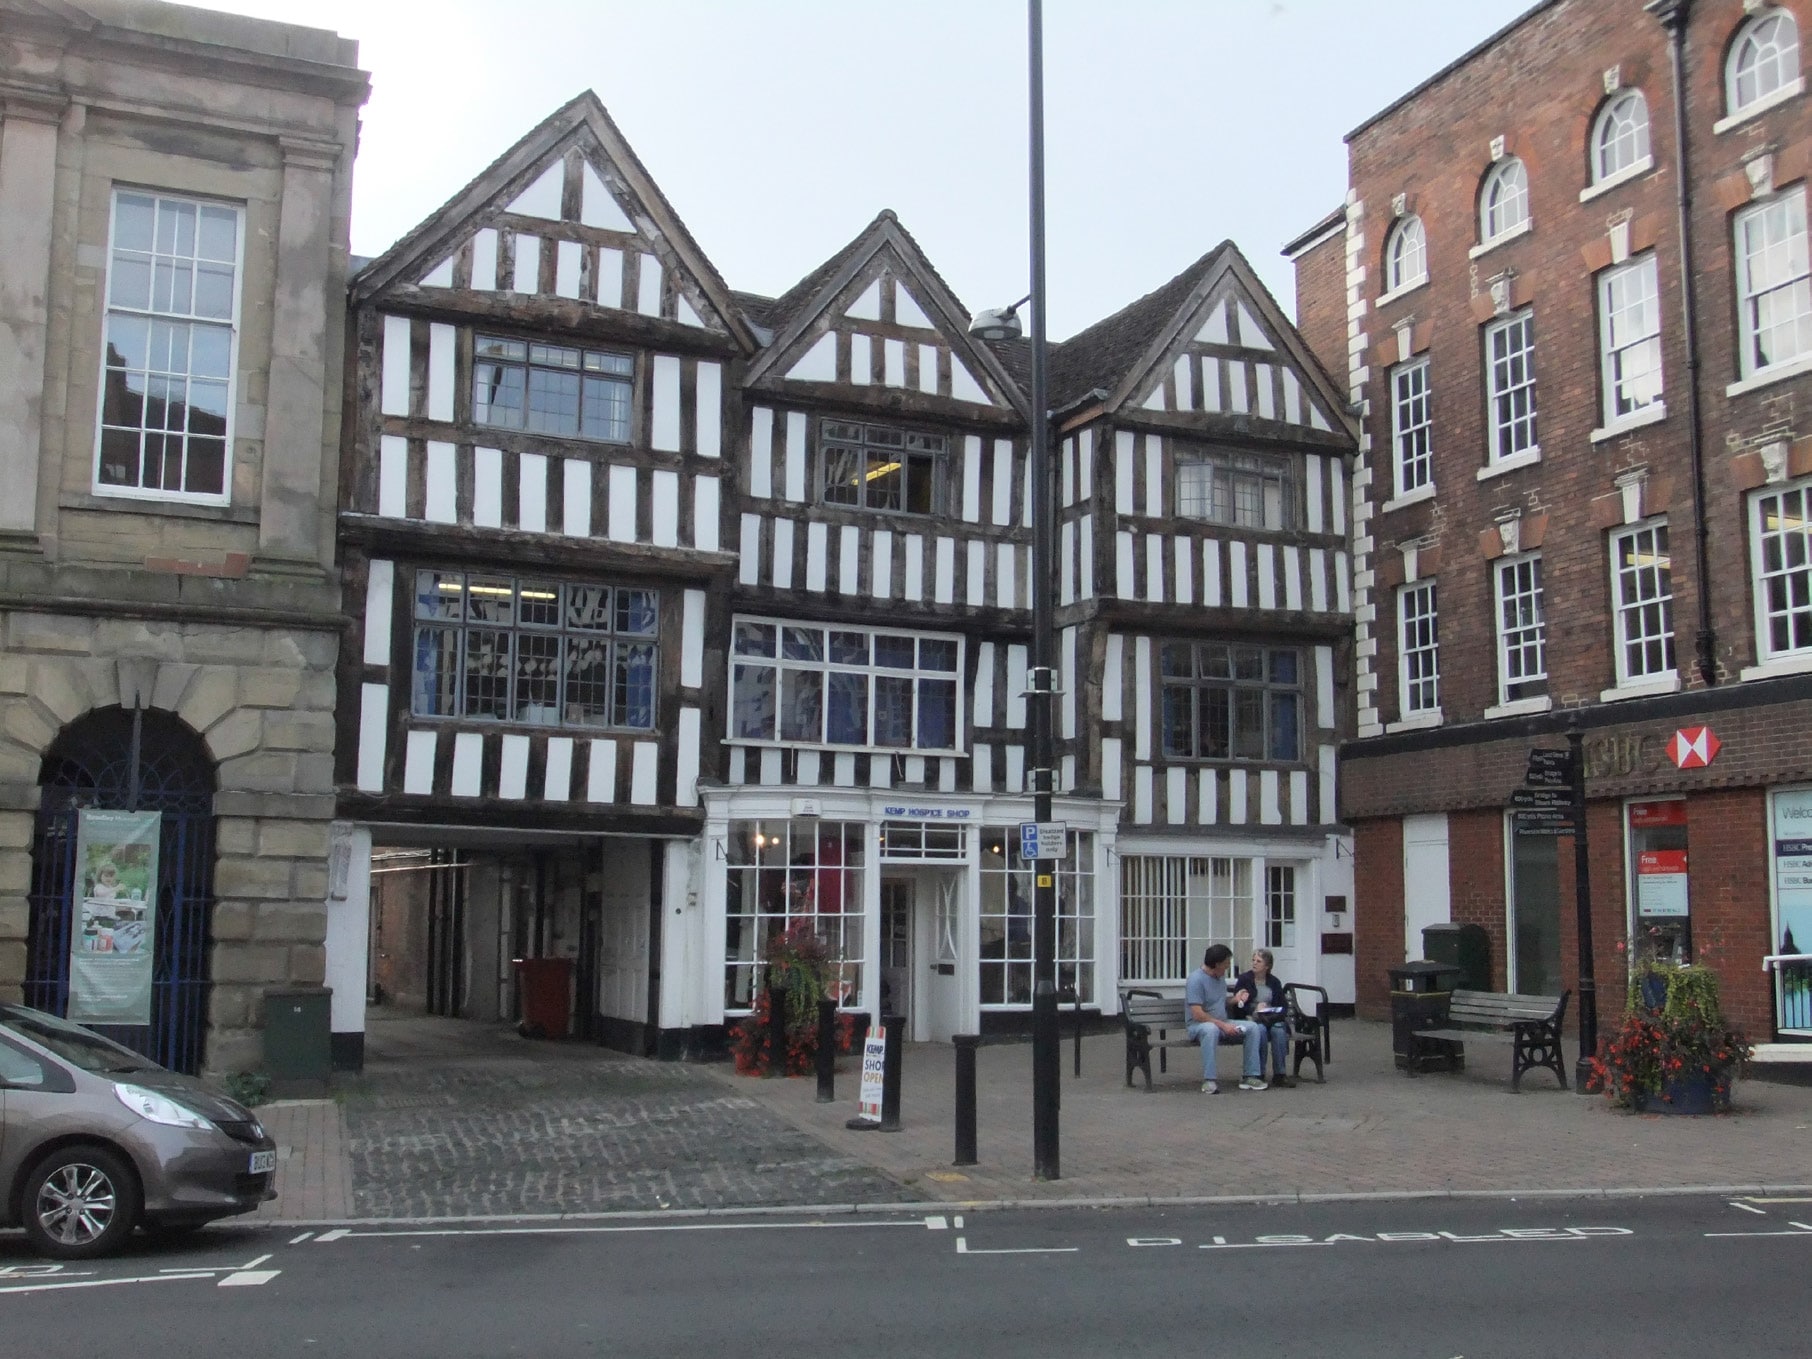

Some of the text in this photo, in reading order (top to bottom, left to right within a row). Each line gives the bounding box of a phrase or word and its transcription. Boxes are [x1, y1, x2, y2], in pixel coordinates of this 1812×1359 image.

[884, 806, 970, 818] KEMP HOSPICE SHOP
[1025, 826, 1036, 840] P
[1126, 1227, 1635, 1247] DISABLED
